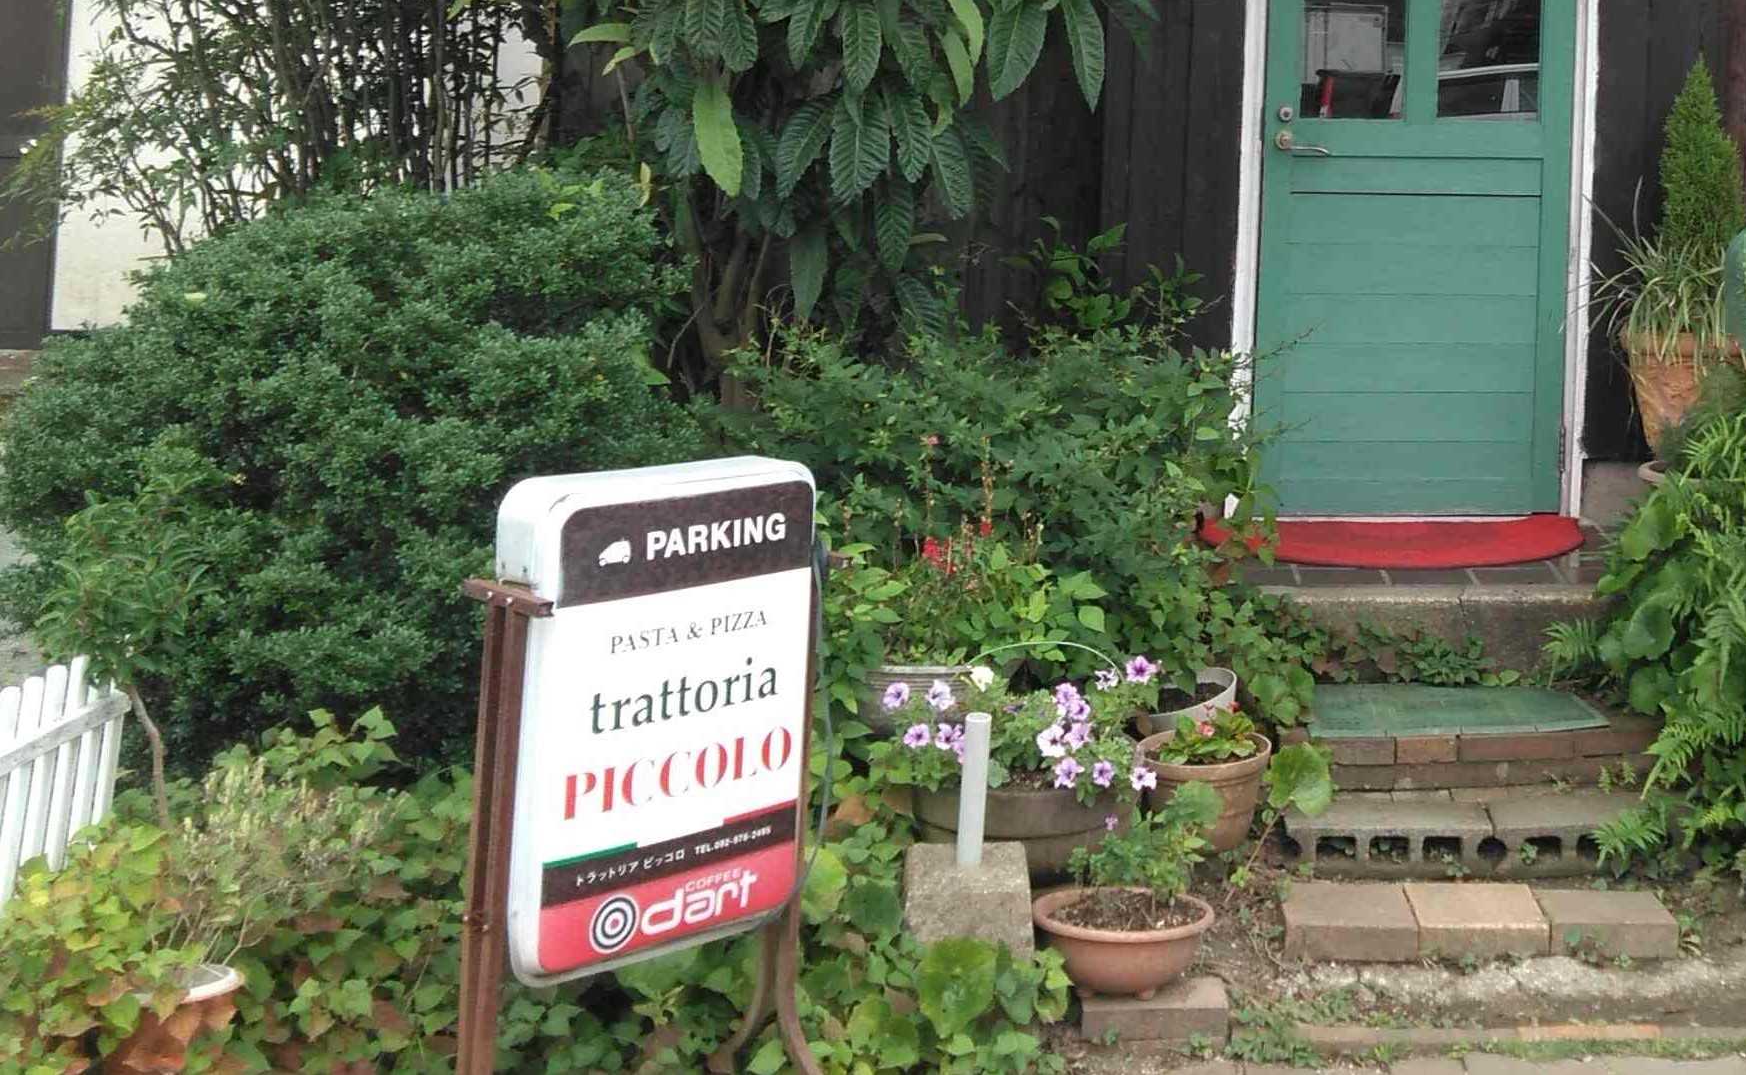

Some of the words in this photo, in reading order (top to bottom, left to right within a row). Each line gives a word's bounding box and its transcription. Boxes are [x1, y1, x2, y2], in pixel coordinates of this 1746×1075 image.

[645, 512, 787, 562] PARKING
[610, 627, 680, 655] PASTA
[686, 622, 703, 640] &
[710, 610, 769, 636] PIZZA
[589, 656, 778, 735] trattoria
[564, 726, 792, 821] PICCOLO
[641, 870, 758, 936] dart
[684, 867, 743, 893] COFFEE
